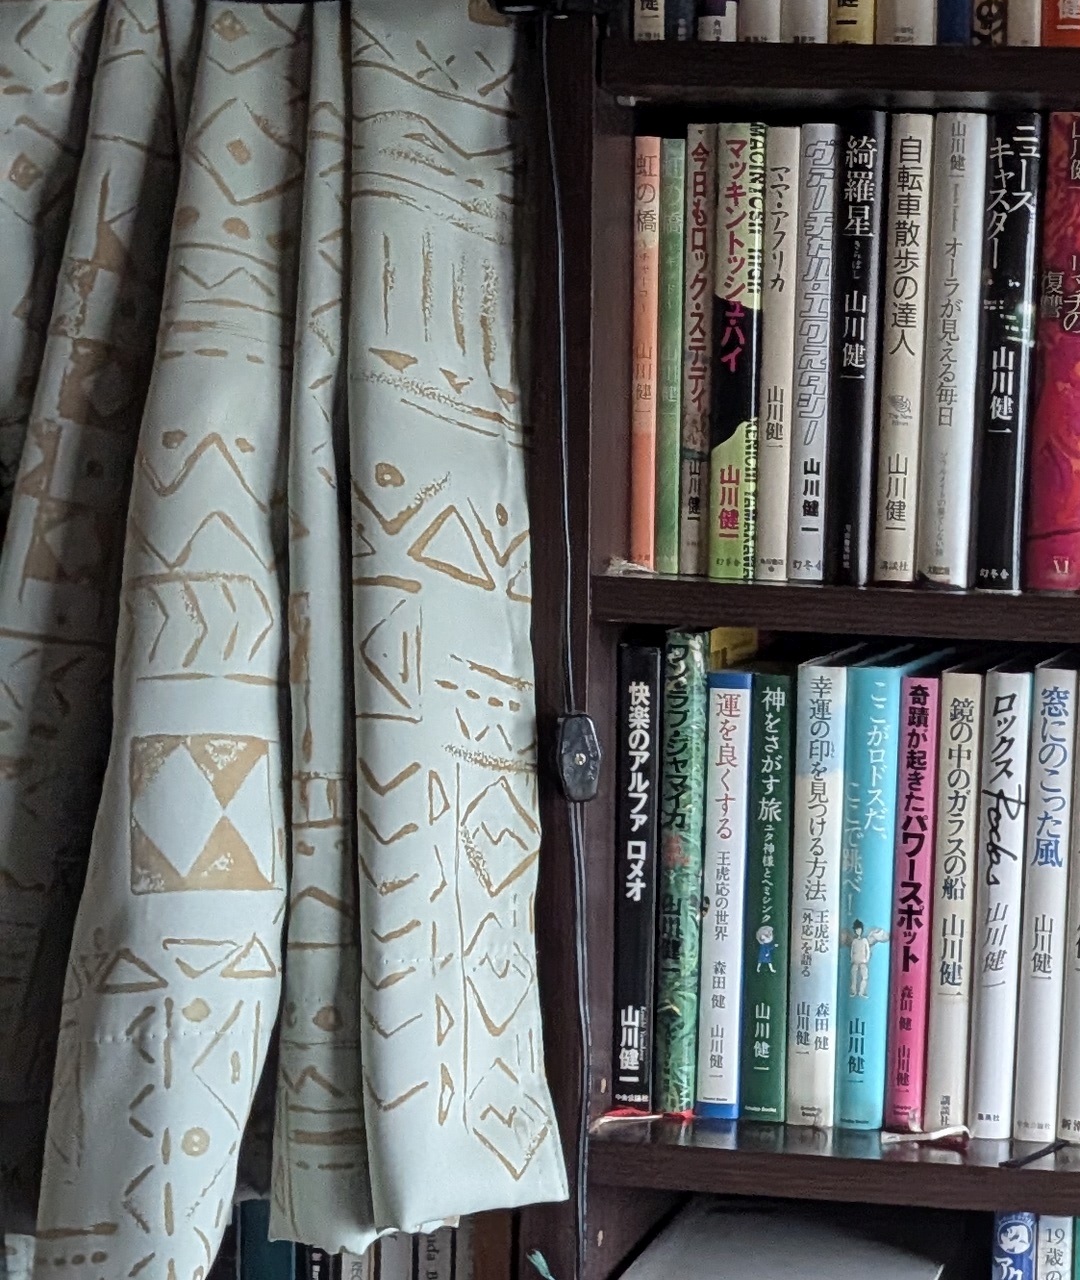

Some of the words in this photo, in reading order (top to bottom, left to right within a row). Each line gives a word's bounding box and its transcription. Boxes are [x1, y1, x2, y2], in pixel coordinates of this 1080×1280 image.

[634, 154, 657, 233] 虹の橋
[844, 136, 877, 238] 綺羅星
[890, 136, 923, 355] 自転車散歩の達人
[765, 385, 783, 450] 山川健一
[801, 458, 820, 532] 山川健一
[886, 454, 907, 531] 山川健一
[714, 693, 740, 840] 運を良くする
[758, 686, 786, 821] 神をさがす旅
[804, 675, 832, 901] 幸運の印を見つける方法
[941, 698, 973, 900] 鏡の中のガラスの船
[993, 693, 1017, 777] ロックス
[1031, 687, 1069, 867] 窓にのこった風
[896, 686, 930, 972] 奇蹟が起きたパワースポット
